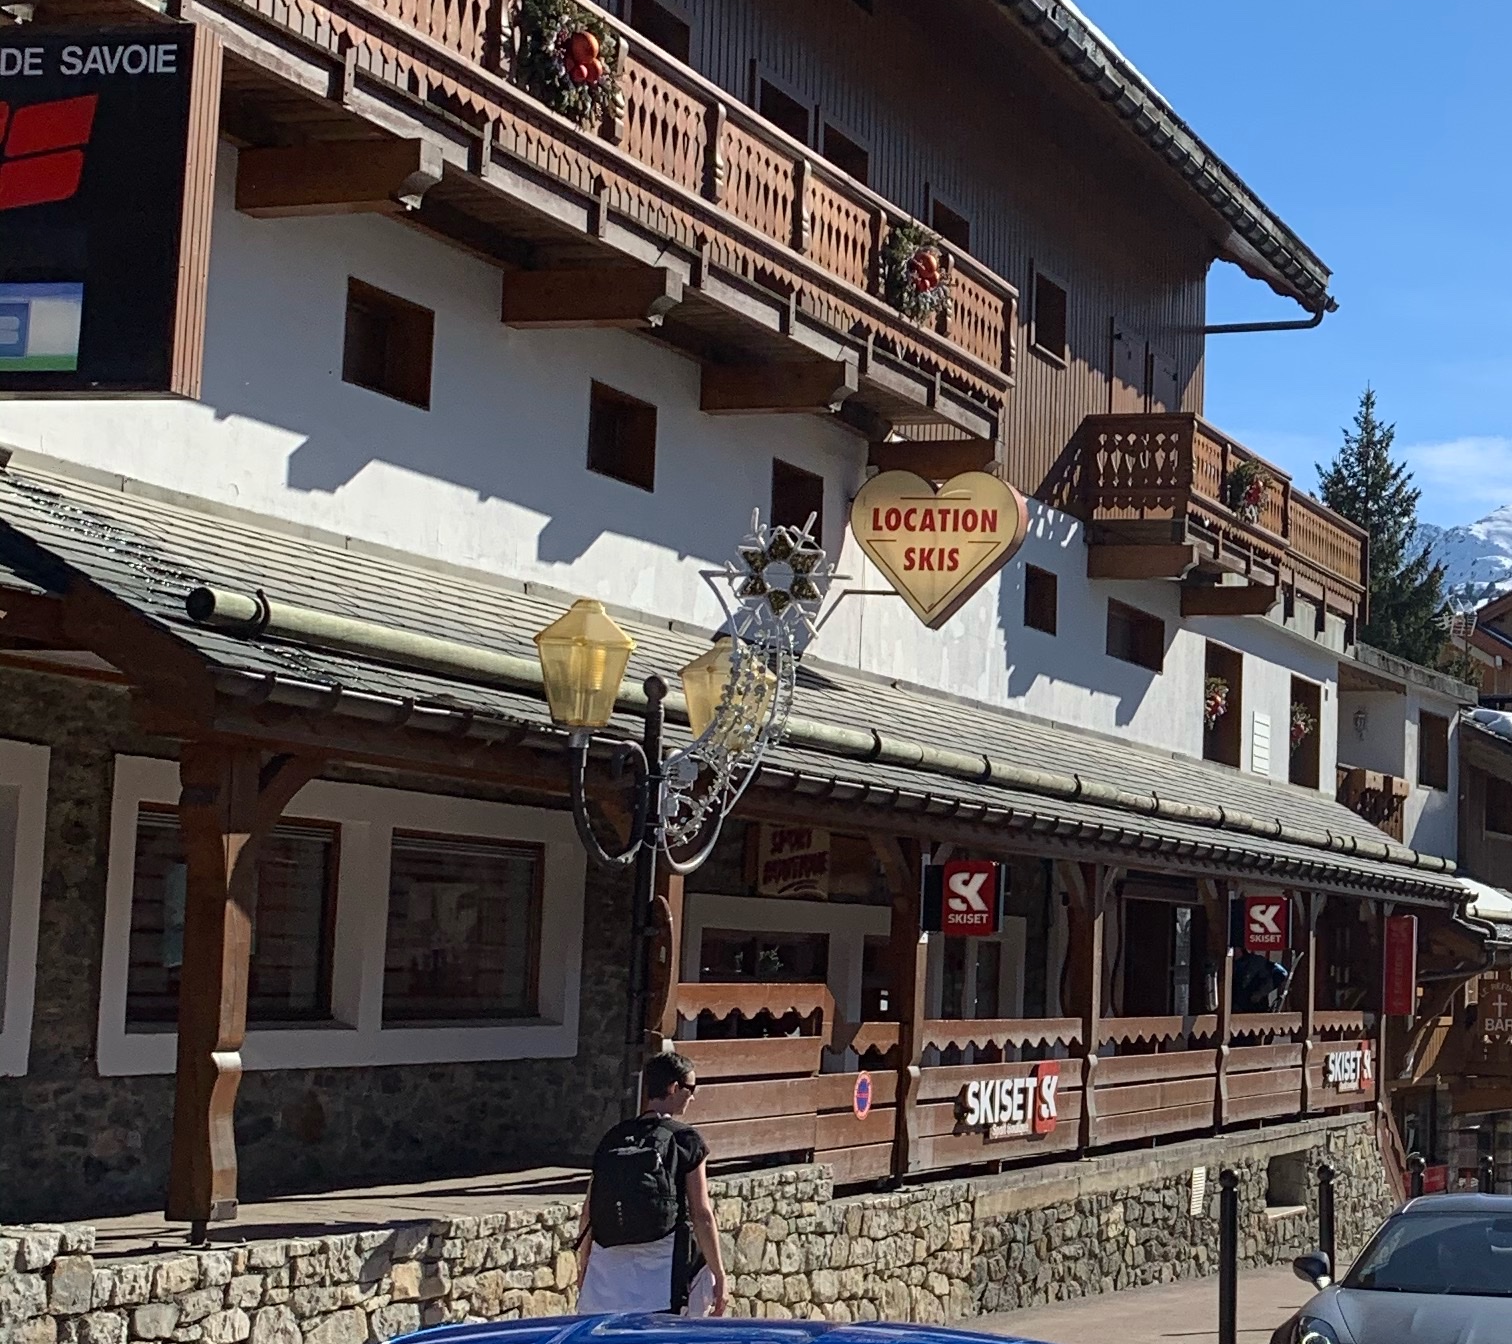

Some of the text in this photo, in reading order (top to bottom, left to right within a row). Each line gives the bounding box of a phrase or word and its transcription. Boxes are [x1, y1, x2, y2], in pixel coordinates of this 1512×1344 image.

[0, 44, 178, 76] DE SAVOIE
[872, 507, 998, 533] LOCATION
[903, 547, 960, 572] SKIS
[947, 913, 989, 924] SKISET
[1249, 934, 1282, 943] SKISET
[1328, 1050, 1362, 1083] SKISET
[966, 1077, 1038, 1126] SKISET
